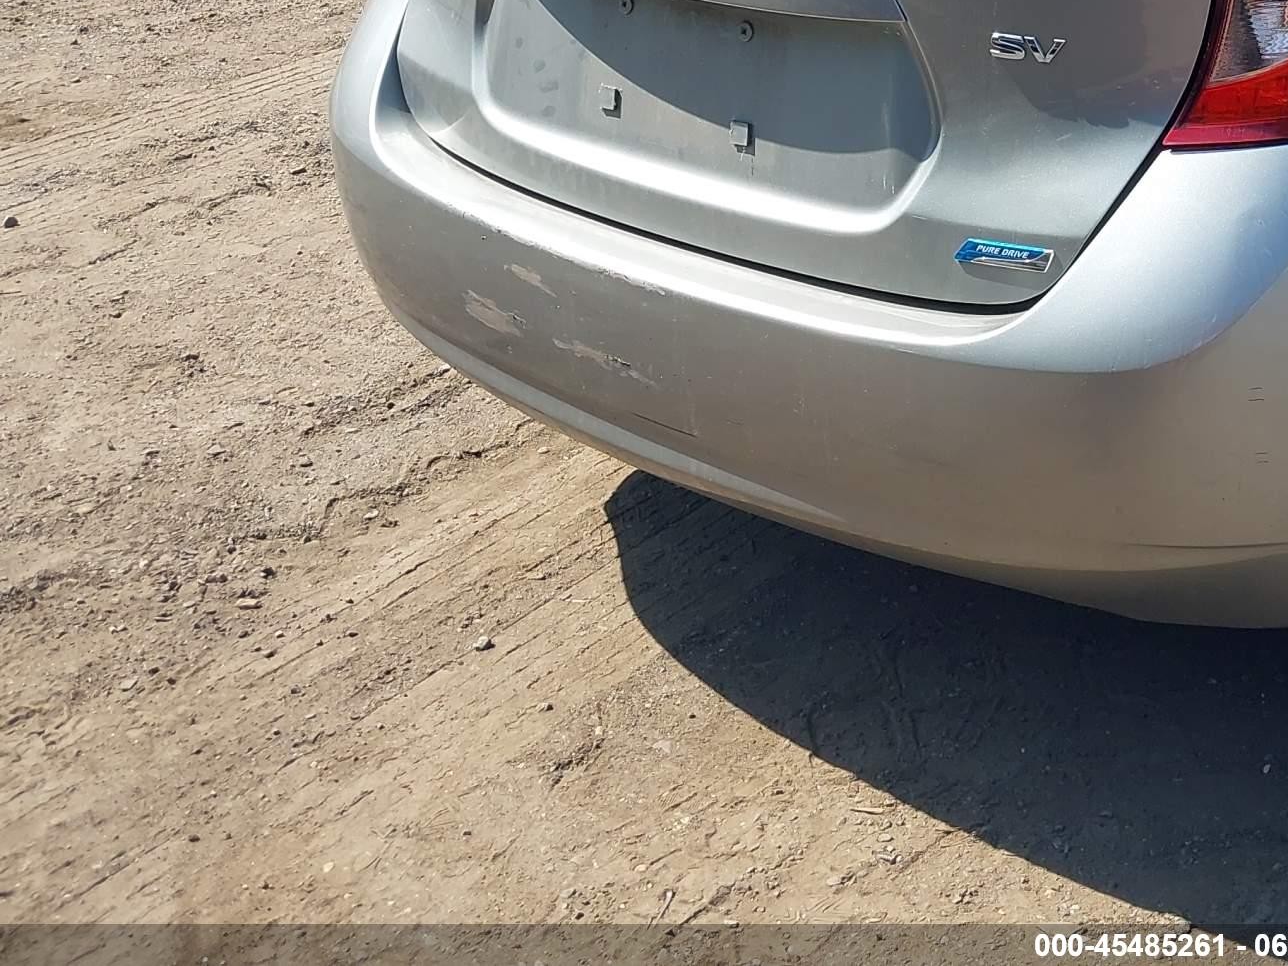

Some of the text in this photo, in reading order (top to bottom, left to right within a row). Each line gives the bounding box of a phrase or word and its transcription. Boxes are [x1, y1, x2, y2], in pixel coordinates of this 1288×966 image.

[989, 32, 1067, 64] SV
[976, 244, 1030, 259] PURE DRIVE
